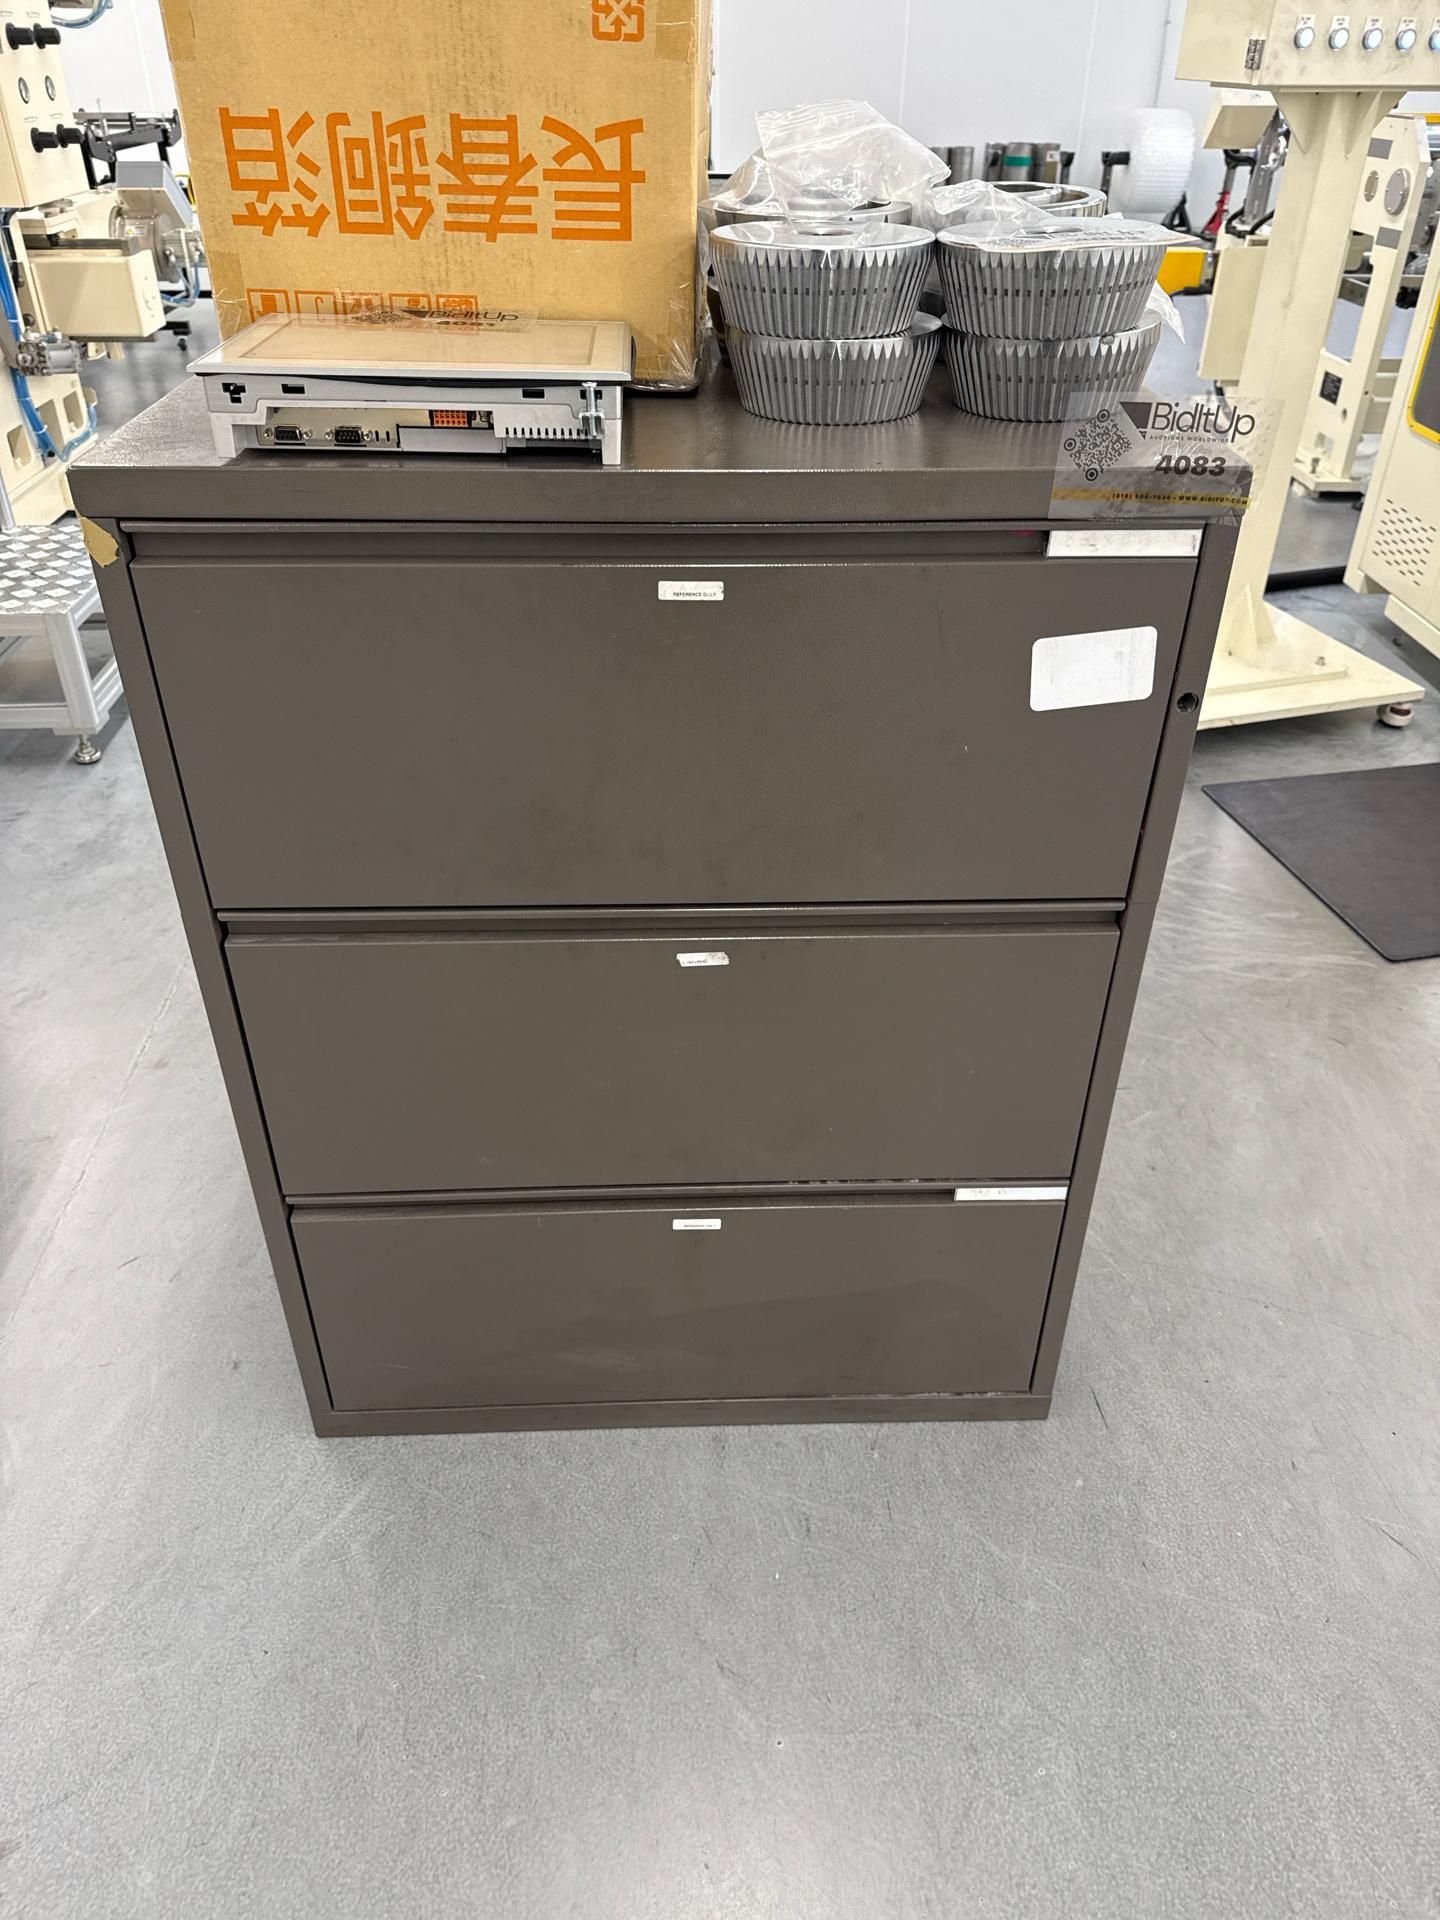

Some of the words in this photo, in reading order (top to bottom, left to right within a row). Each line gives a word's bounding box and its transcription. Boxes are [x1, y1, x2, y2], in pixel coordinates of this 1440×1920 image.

[219, 107, 646, 242] 長春銅箔
[429, 310, 519, 322] BidItUp
[1151, 401, 1255, 443] BidItUp
[1187, 435, 1229, 443] WORLDWIDE
[1154, 454, 1227, 477] 4083
